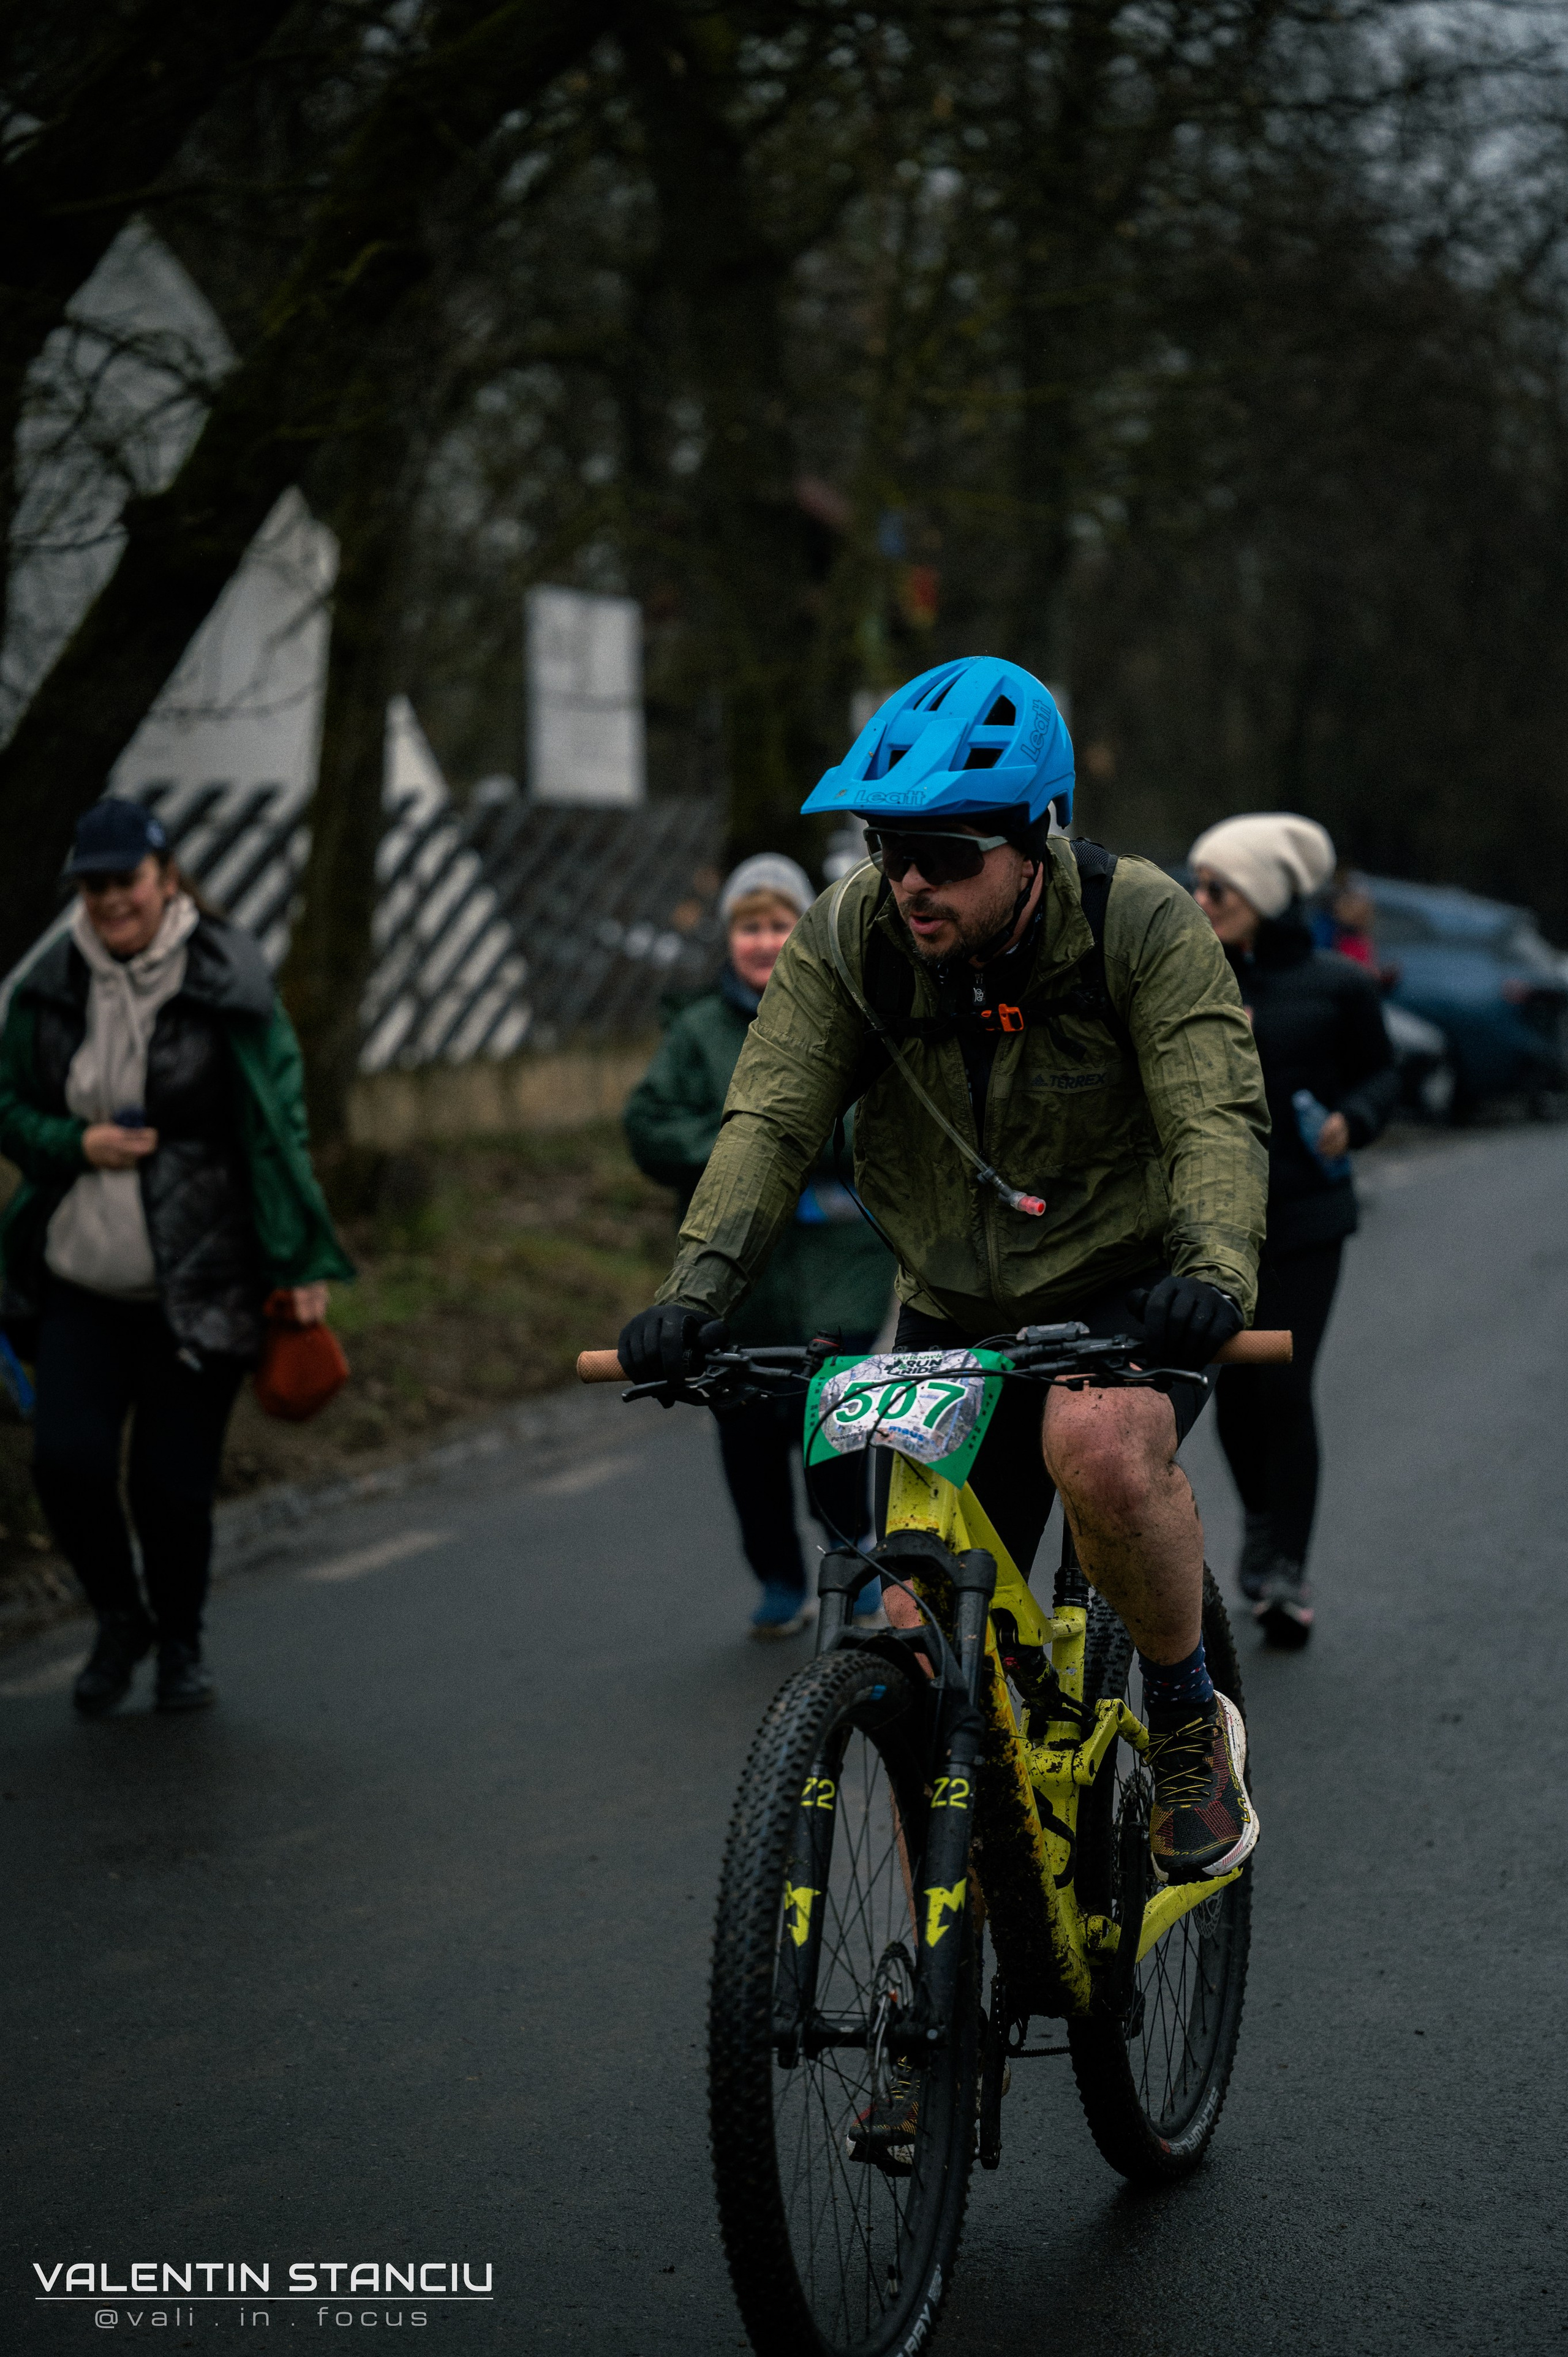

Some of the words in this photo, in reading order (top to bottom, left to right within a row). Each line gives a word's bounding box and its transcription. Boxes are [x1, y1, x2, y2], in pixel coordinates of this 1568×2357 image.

[1020, 698, 1053, 763] Leatt
[854, 789, 926, 805] Leatt
[1050, 1073, 1106, 1089] TERREX
[906, 1359, 943, 1367] RUN
[834, 1380, 968, 1429] 507
[801, 1777, 835, 1810] Z2
[930, 1776, 970, 1810] Z2
[1168, 2086, 1220, 2155] SCHWALBE
